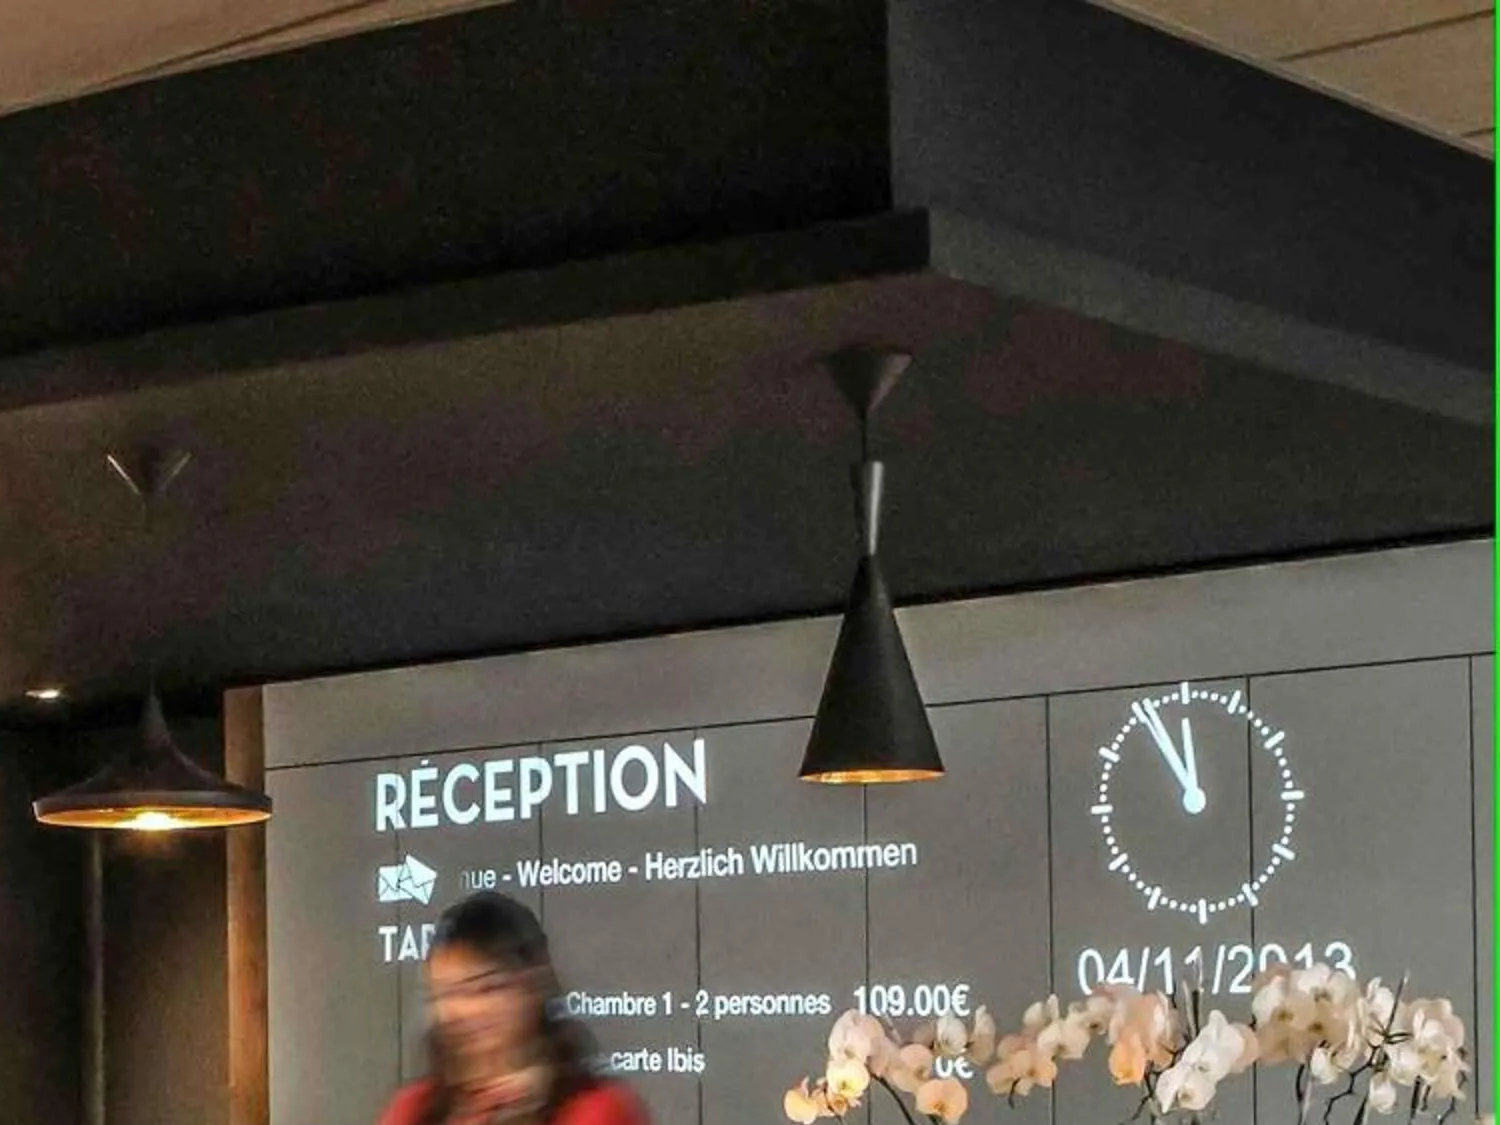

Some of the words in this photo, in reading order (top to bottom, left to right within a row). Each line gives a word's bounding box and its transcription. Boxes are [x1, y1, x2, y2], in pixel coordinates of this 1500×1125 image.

[375, 738, 707, 832] RÉCEPTION
[516, 858, 622, 888] Welcome
[645, 847, 744, 880] Herzlich
[750, 841, 918, 875] Willkommen
[566, 991, 657, 1016] Chambre
[662, 991, 672, 1015] 1
[694, 989, 709, 1016] 2
[714, 992, 832, 1019] personnes
[853, 983, 972, 1016] 109.00€
[610, 1051, 661, 1073] carte
[666, 1047, 706, 1073] Ibis
